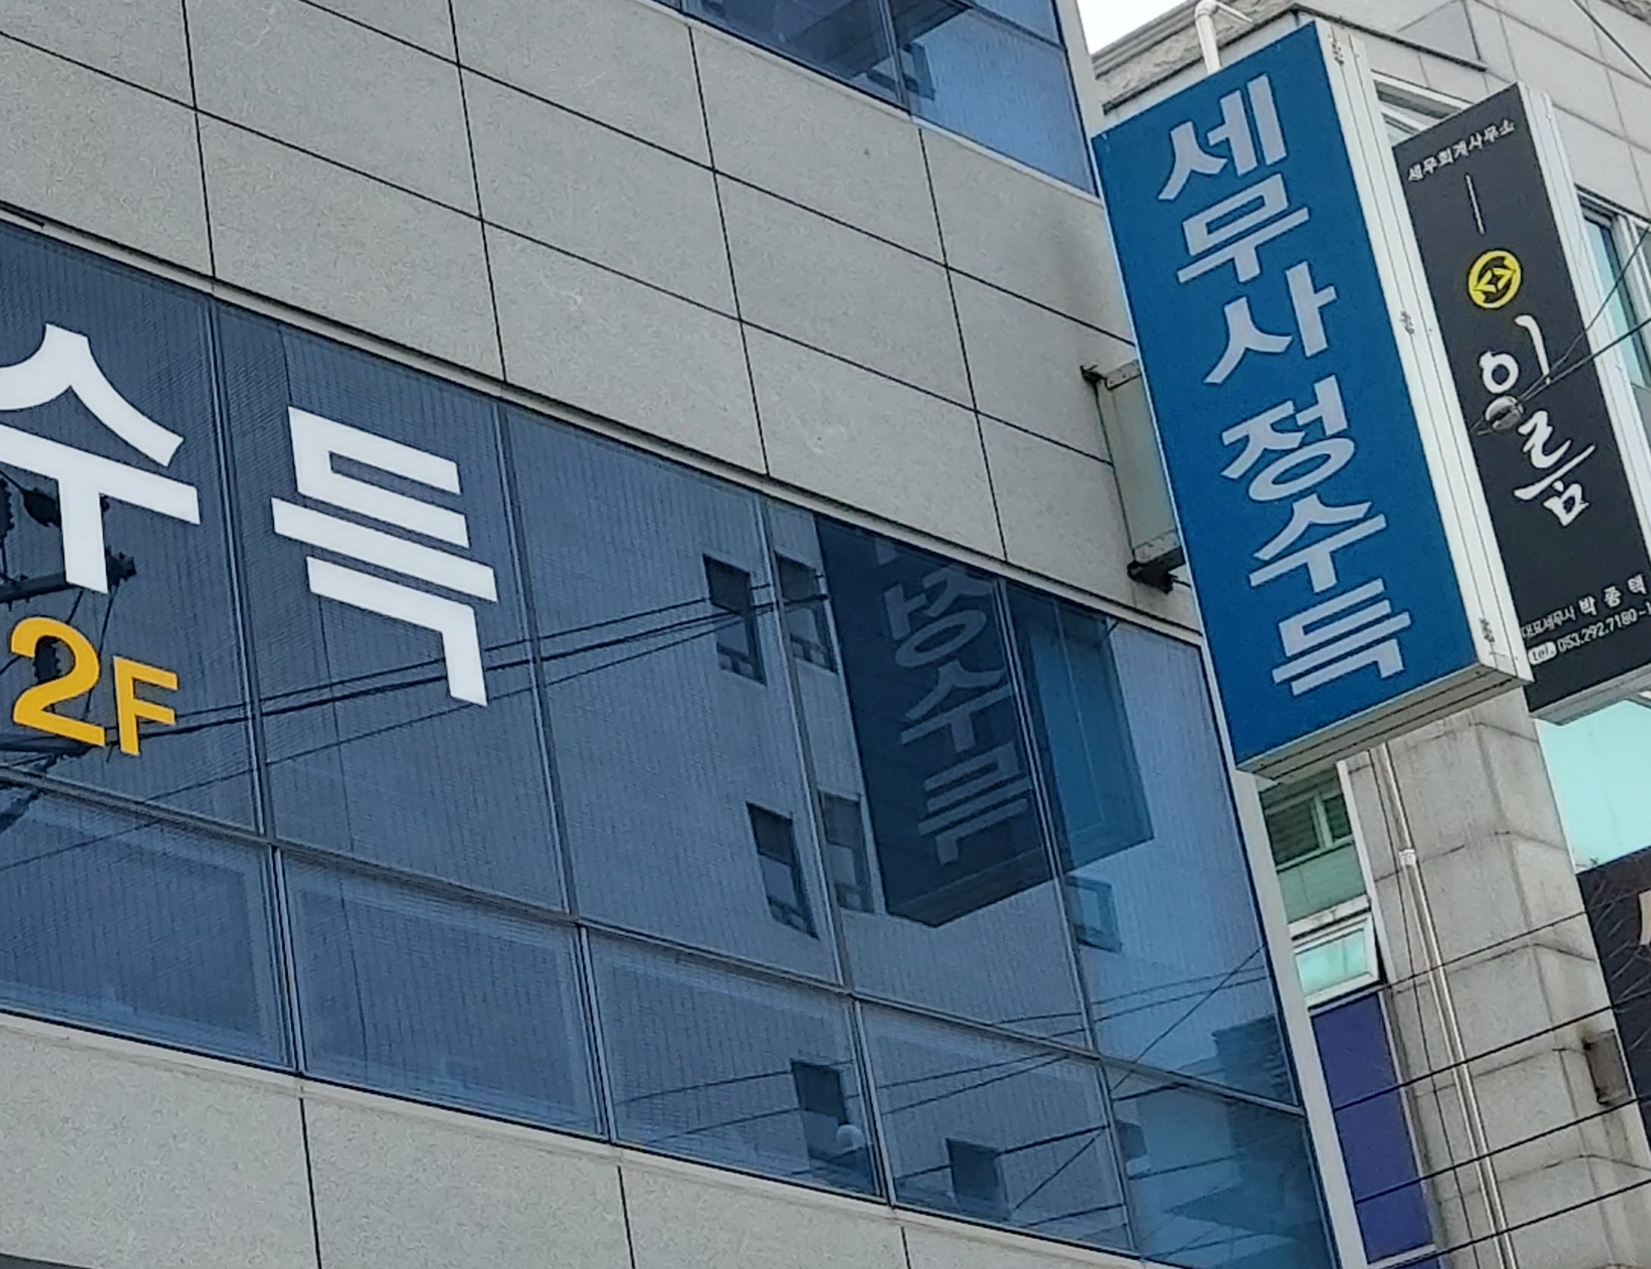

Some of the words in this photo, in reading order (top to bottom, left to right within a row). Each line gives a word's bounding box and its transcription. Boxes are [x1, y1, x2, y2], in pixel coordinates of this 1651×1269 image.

[1157, 74, 1338, 385] 세무사
[9, 615, 180, 757] 2F
[1219, 373, 1413, 698] 정수득
